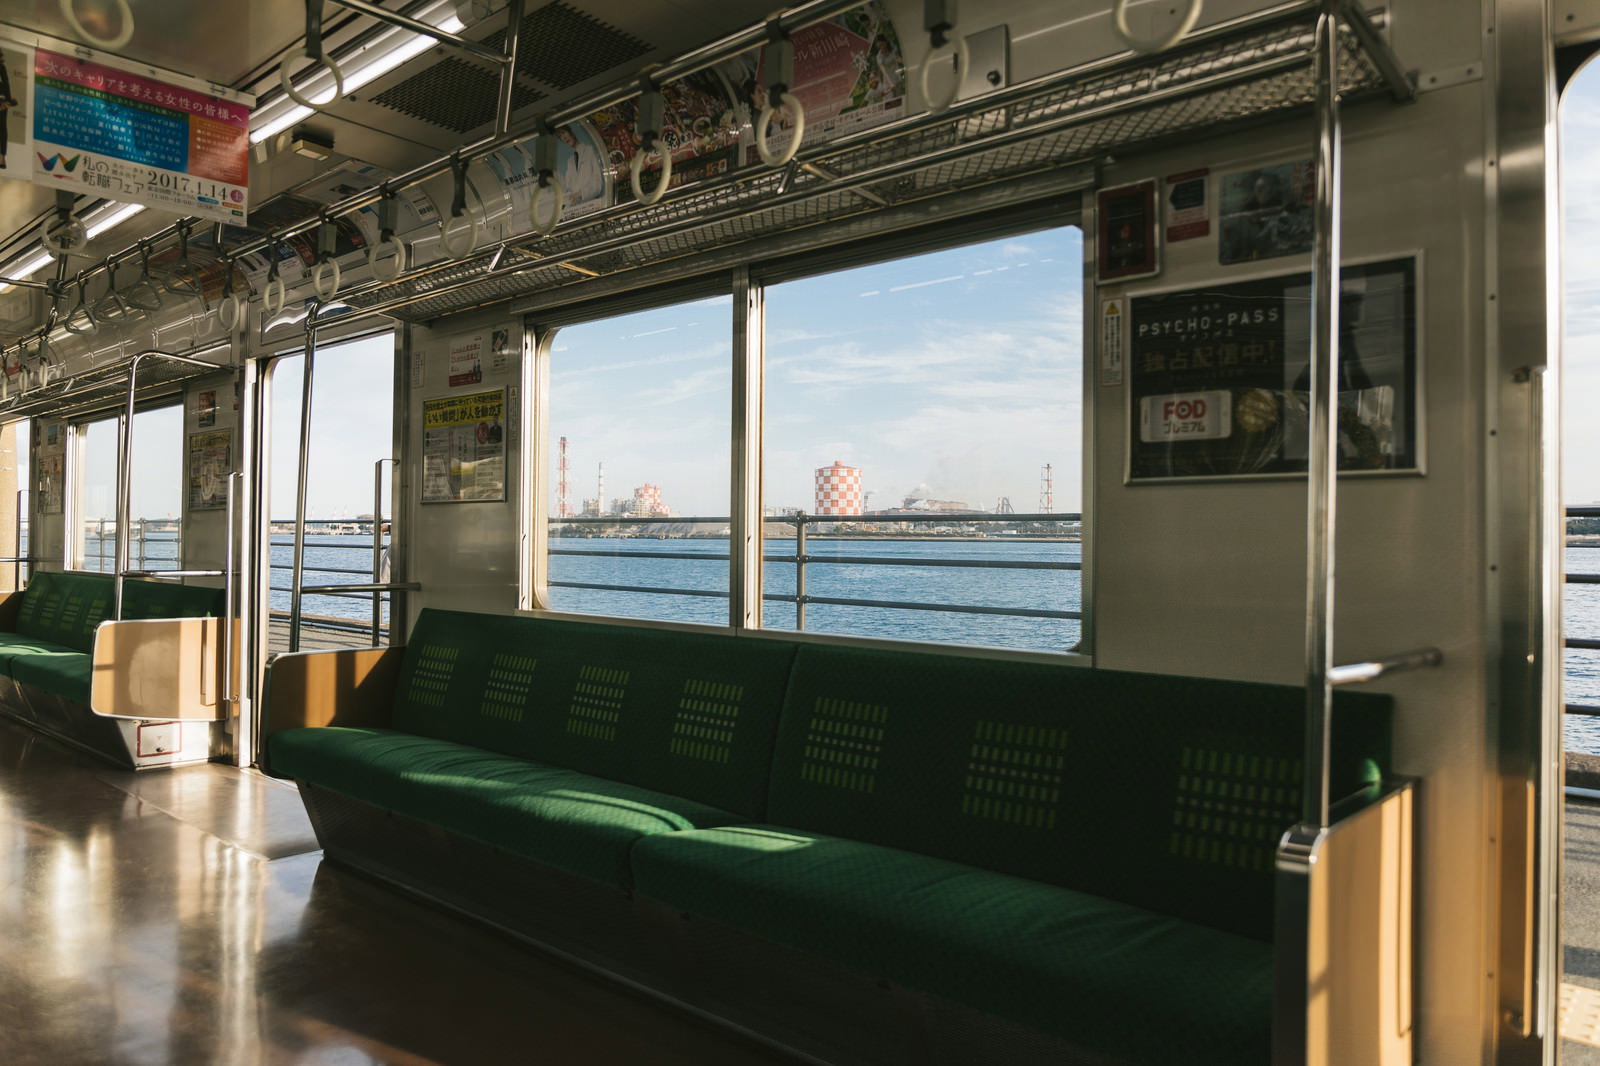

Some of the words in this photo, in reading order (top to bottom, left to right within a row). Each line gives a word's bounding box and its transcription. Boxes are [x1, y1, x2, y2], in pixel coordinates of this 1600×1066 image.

[45, 59, 243, 123] 次のキャリアを考える女性の皆様へ
[83, 155, 110, 174] 私の
[81, 171, 145, 195] 転職フェア
[147, 170, 228, 200] 2017.1.14
[1138, 307, 1279, 337] PSYCHO-PASS
[1163, 399, 1207, 421] FOD
[1163, 420, 1206, 434] プレミアム
